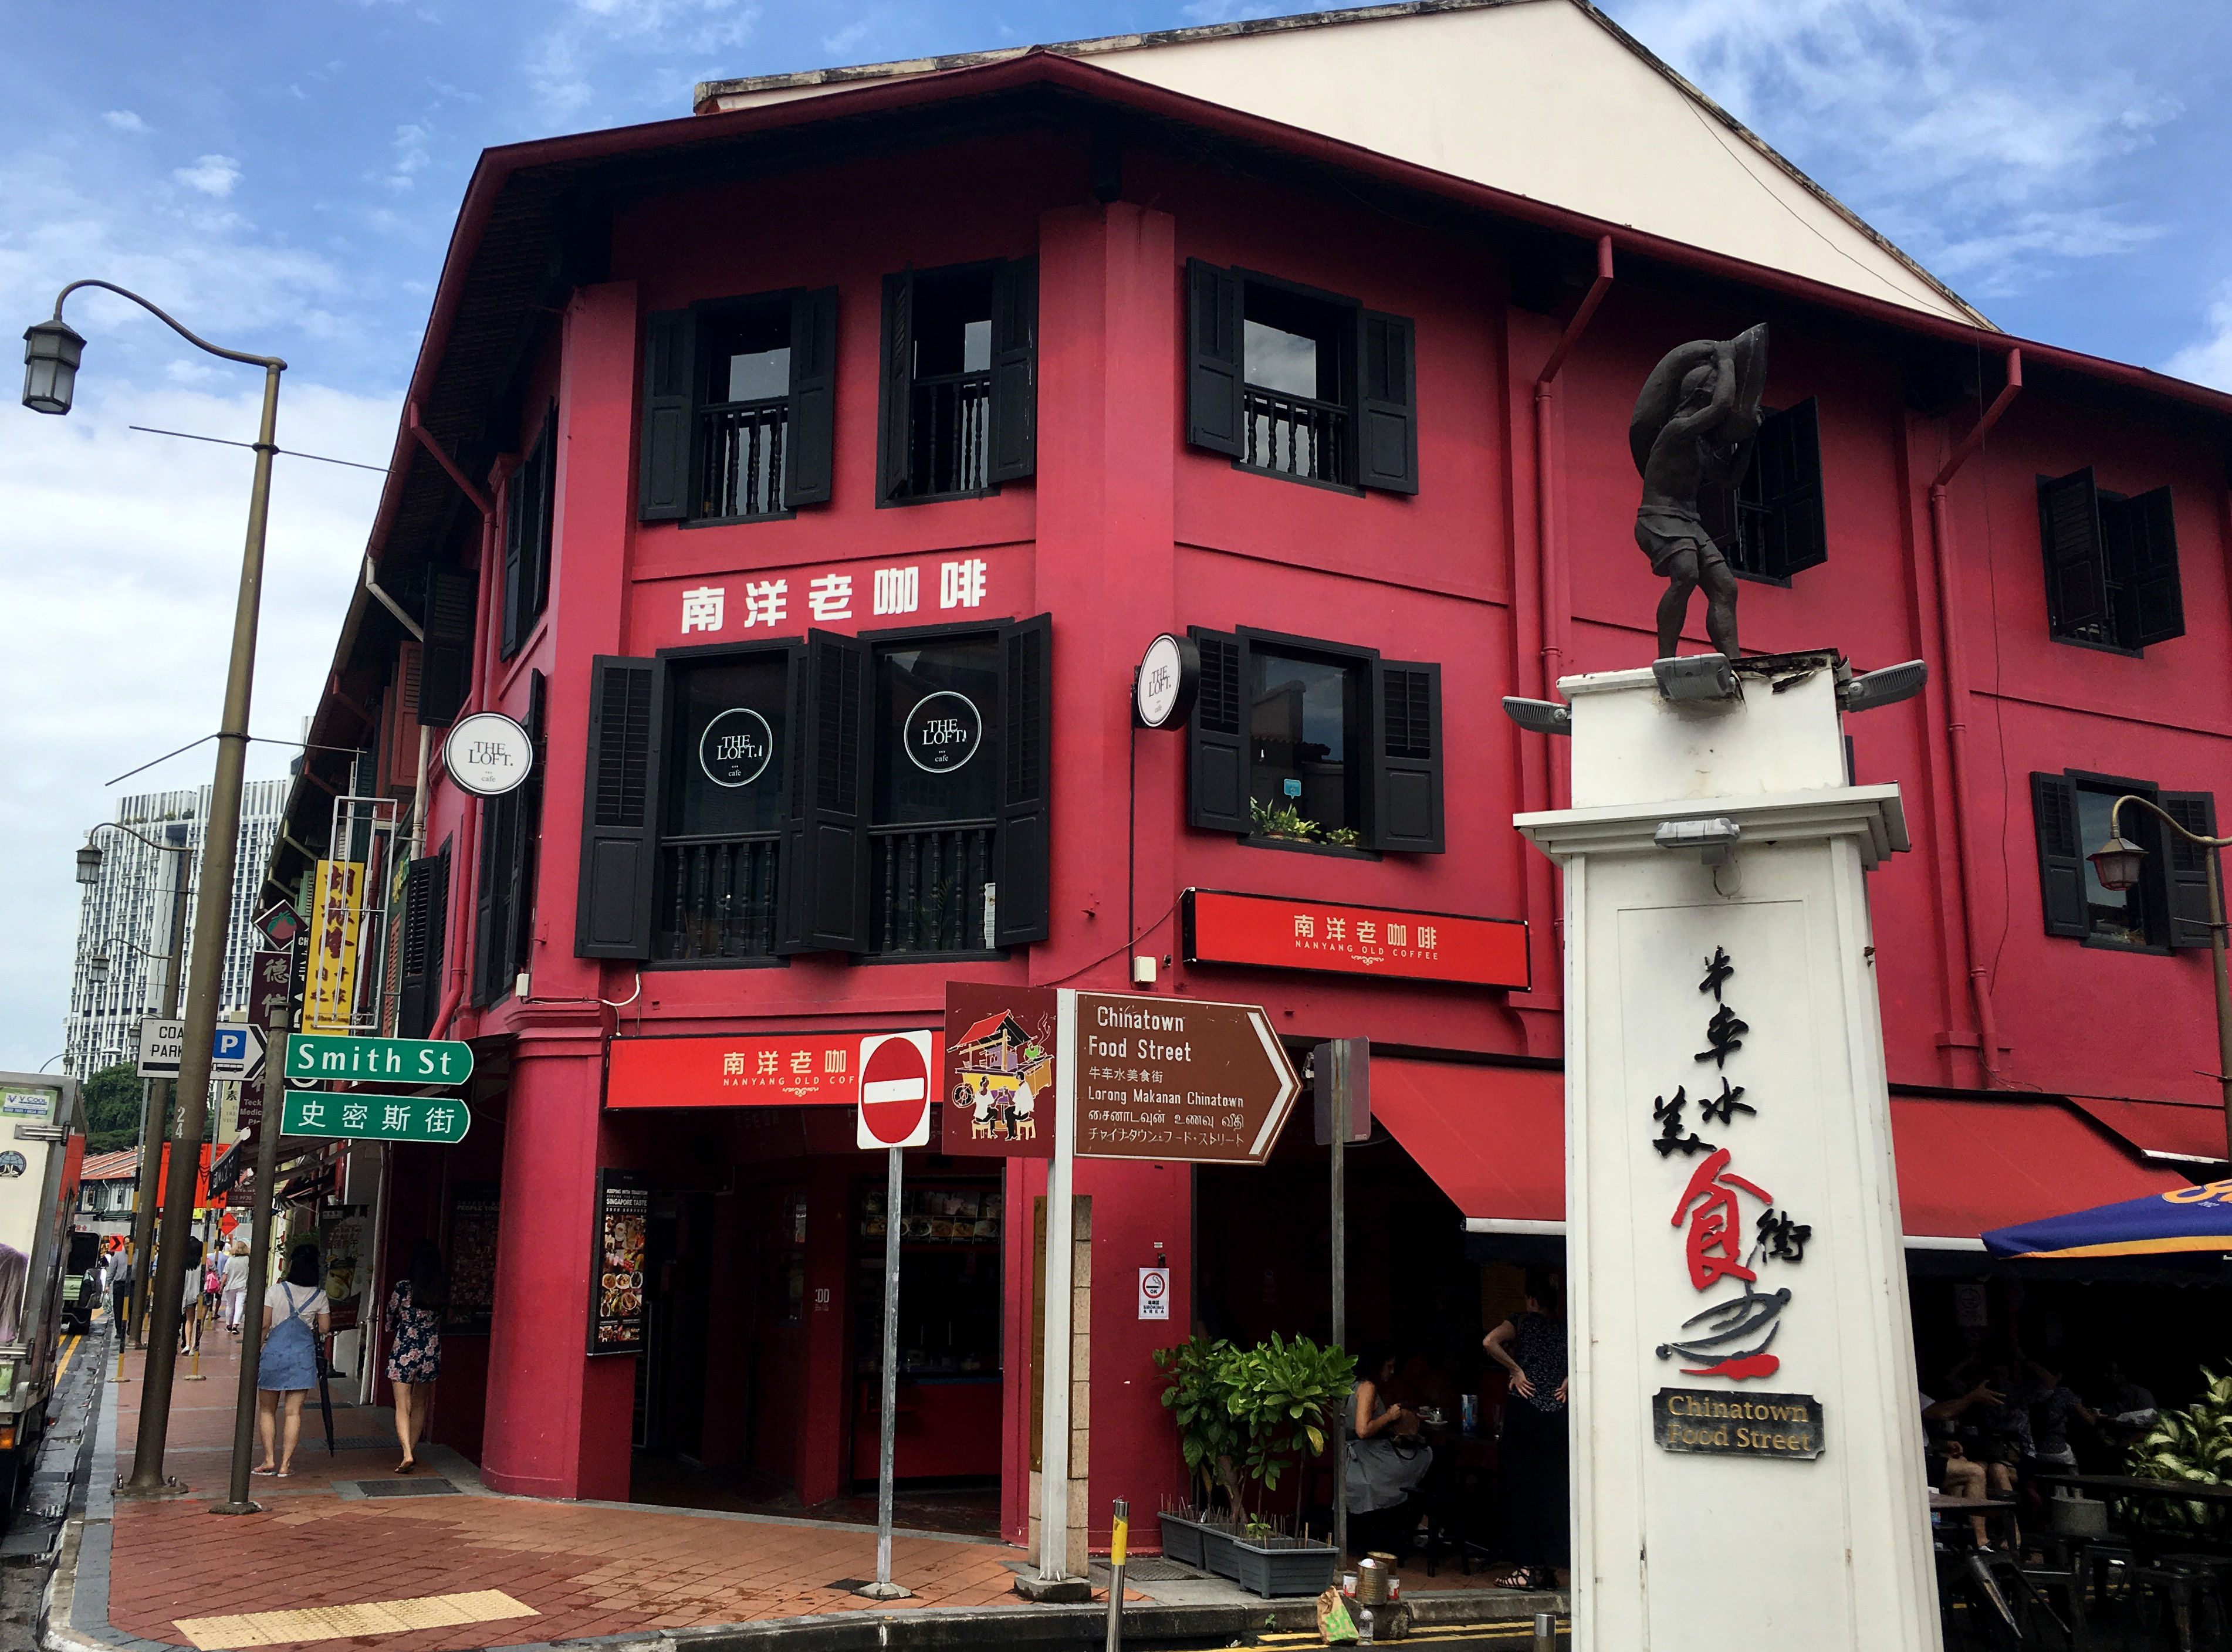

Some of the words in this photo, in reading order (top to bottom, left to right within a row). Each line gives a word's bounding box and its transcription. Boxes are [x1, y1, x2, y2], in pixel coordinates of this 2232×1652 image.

[681, 558, 987, 634] 南洋老咖啡
[1152, 665, 1168, 683] THE
[1148, 676, 1171, 697] LOFT.
[927, 719, 958, 733] THE
[474, 742, 506, 754] THE
[722, 734, 750, 748] THE
[468, 749, 513, 766] LOFT.
[935, 754, 949, 763] cafe
[728, 769, 742, 777] cafe
[1294, 914, 1437, 950] 南洋老咖啡
[1295, 940, 1352, 953] NANYANG
[1361, 945, 1384, 956] OLD
[1392, 949, 1439, 960] COFFEE
[1097, 1006, 1183, 1032] Chinatown
[159, 1026, 184, 1039] COA
[1088, 1035, 1127, 1058] Food
[1138, 1039, 1192, 1062] Street
[298, 1044, 400, 1072] Smith
[418, 1049, 451, 1075] St
[723, 1050, 847, 1075] 南洋老咖
[723, 1077, 786, 1086] NANYANG
[794, 1076, 820, 1085] OLD
[829, 1075, 860, 1085] COF
[1089, 1067, 1163, 1084] 牛车水美食街
[1088, 1086, 1127, 1105] Lorong
[1134, 1088, 1181, 1105] Makanan
[1188, 1091, 1243, 1108] Chinatown
[298, 1101, 455, 1133] 史密斯街
[1174, 1114, 1213, 1127] உணவு
[1222, 1113, 1244, 1131] வீதி
[1668, 1395, 1810, 1423] Chinatown
[1668, 1423, 1730, 1447] Food
[1737, 1427, 1811, 1452] Street
